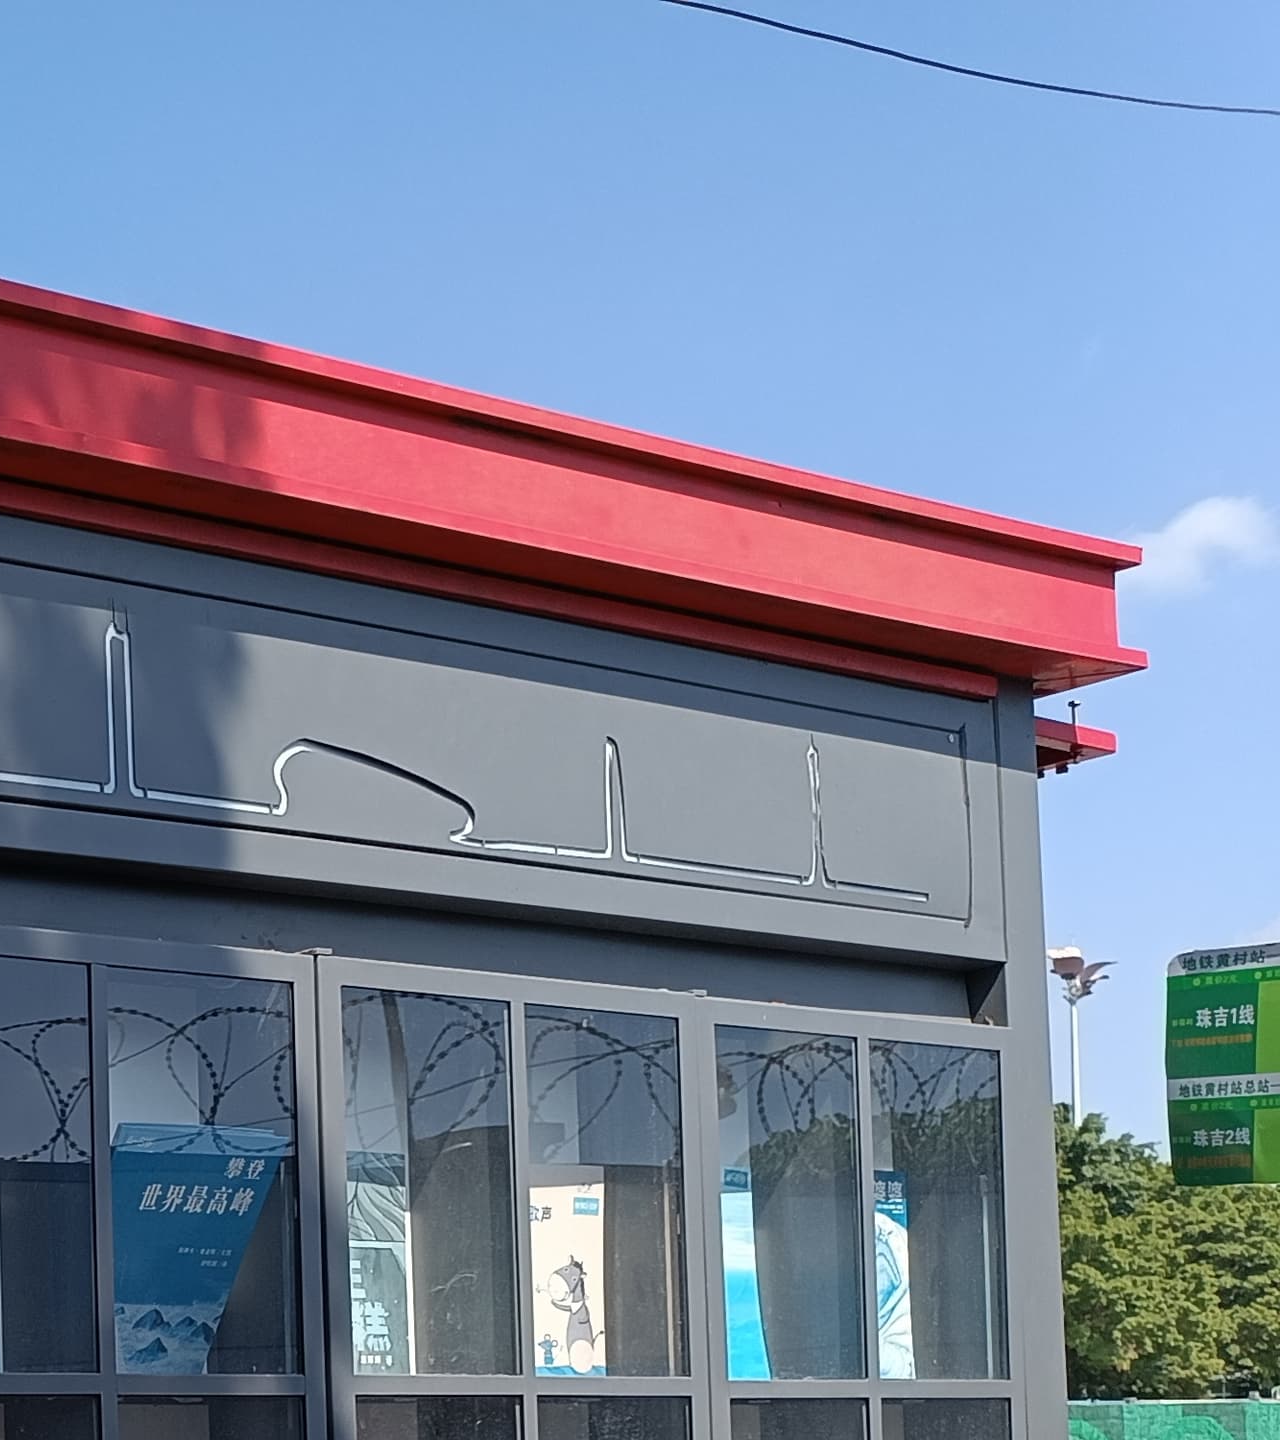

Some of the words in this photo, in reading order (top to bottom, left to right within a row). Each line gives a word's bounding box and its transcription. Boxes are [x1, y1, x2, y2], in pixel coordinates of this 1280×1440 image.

[1181, 949, 1265, 971] 地铁黄村站
[1195, 1003, 1255, 1029] 珠吉1线
[1192, 1127, 1251, 1148] 珠吉2线
[223, 1156, 266, 1181] 攀登
[138, 1182, 256, 1217] 世界最高峰
